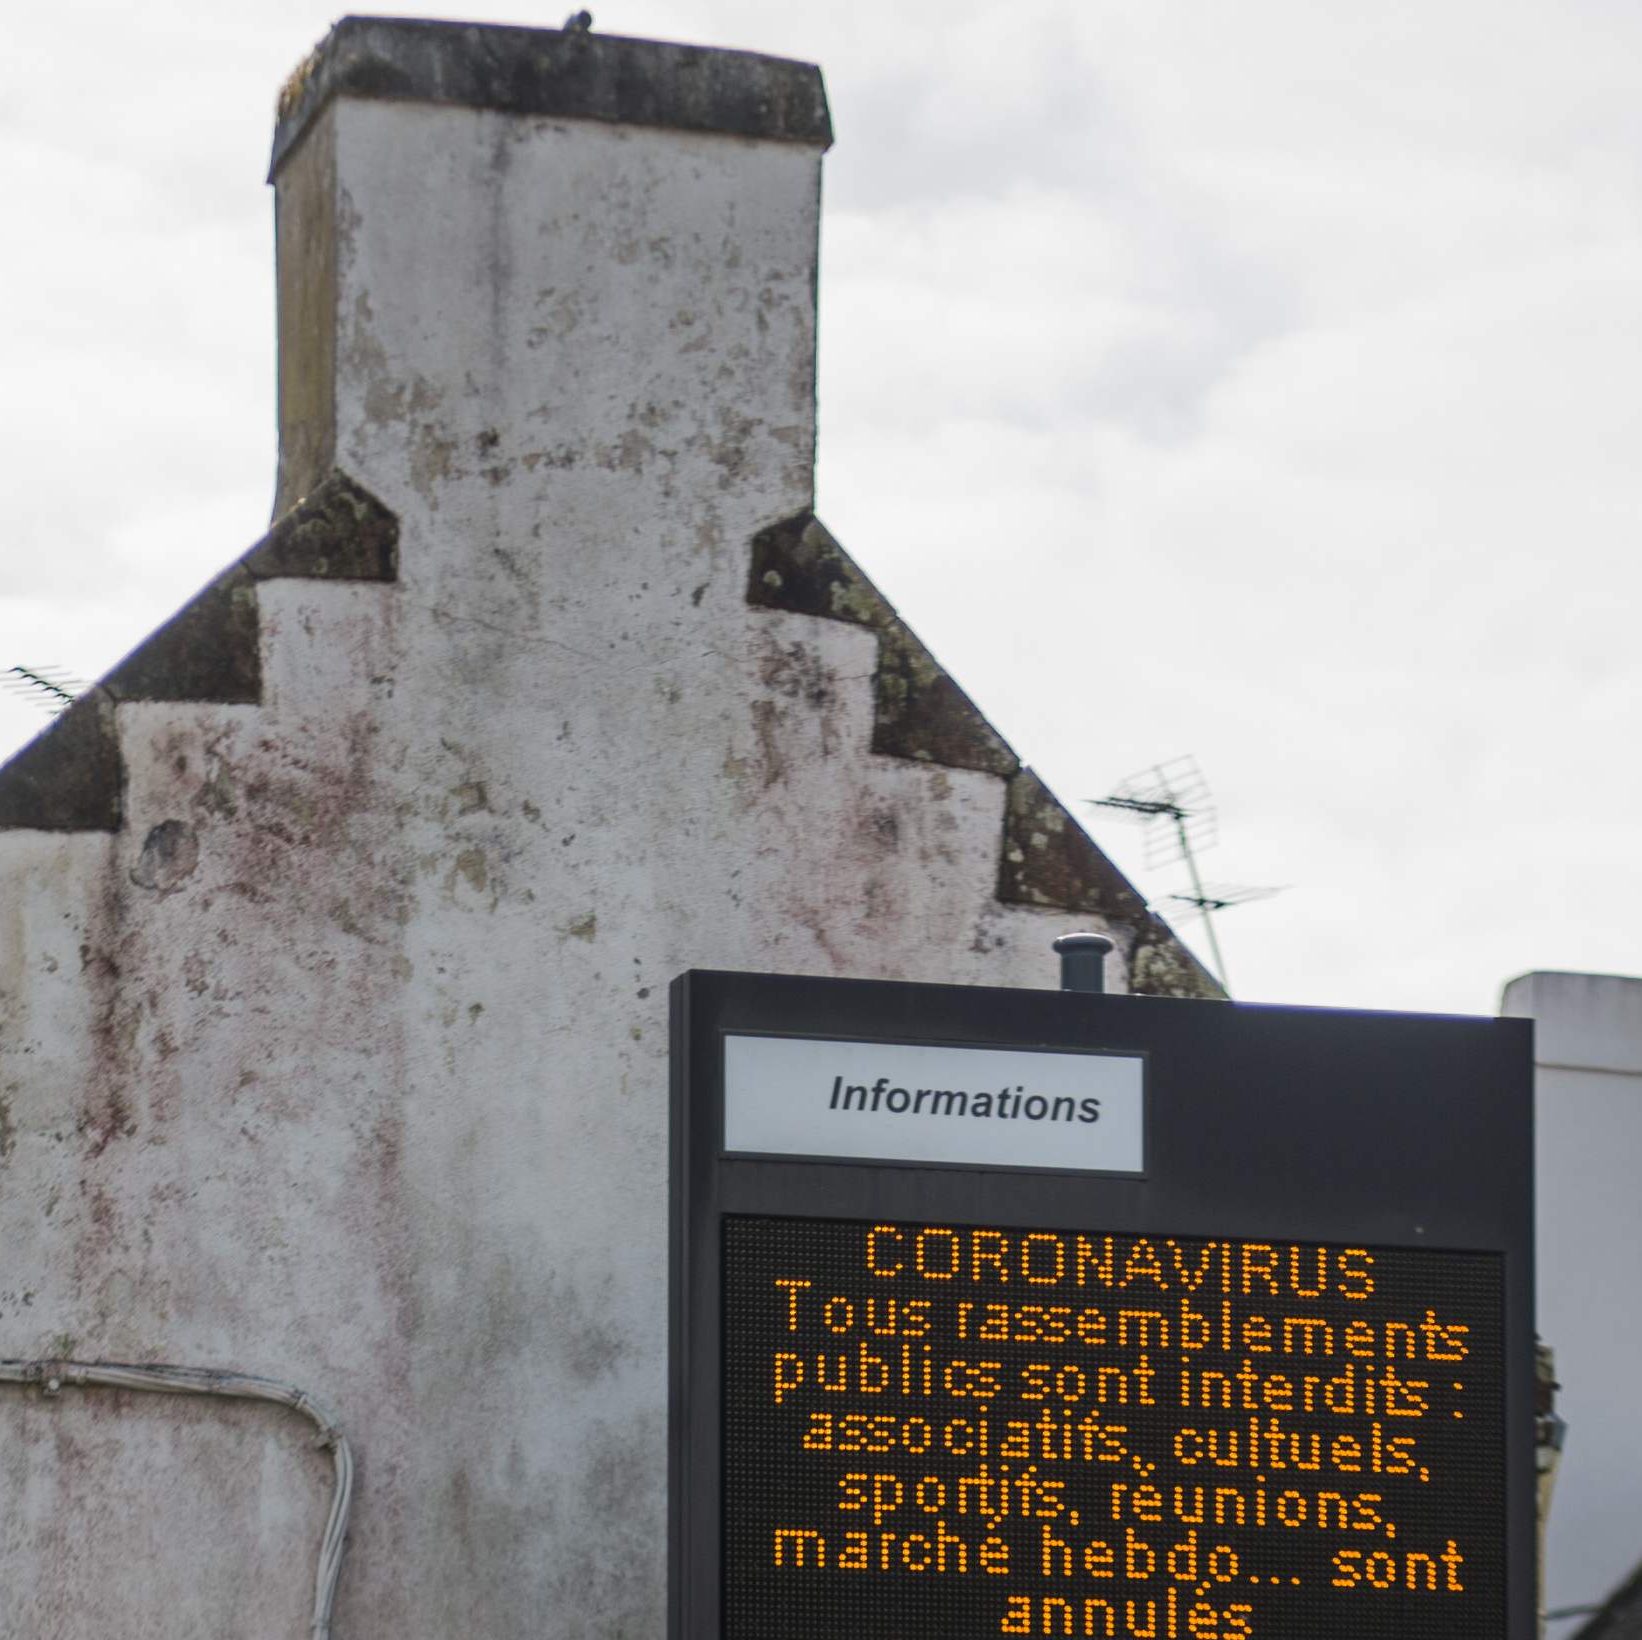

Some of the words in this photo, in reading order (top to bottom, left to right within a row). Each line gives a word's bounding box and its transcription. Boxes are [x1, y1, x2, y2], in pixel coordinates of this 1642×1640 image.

[828, 1075, 1101, 1124] Informations
[866, 1225, 1375, 1300] CORONAVIRUS
[774, 1279, 933, 1338] Tous
[958, 1297, 1470, 1361] rassemblements
[774, 1342, 1002, 1404] publics
[1021, 1354, 1156, 1407] sont
[1180, 1354, 1430, 1417] interdits
[803, 1404, 1141, 1471] associatifs,
[1173, 1416, 1430, 1482] cultuels,
[838, 1463, 1080, 1525] sportifs,
[1111, 1462, 1396, 1539] réunions,
[774, 1515, 1010, 1576] marché
[1041, 1524, 1301, 1586] hebdo...
[1331, 1539, 1464, 1592] sont
[1000, 1581, 1253, 1640] annulés
